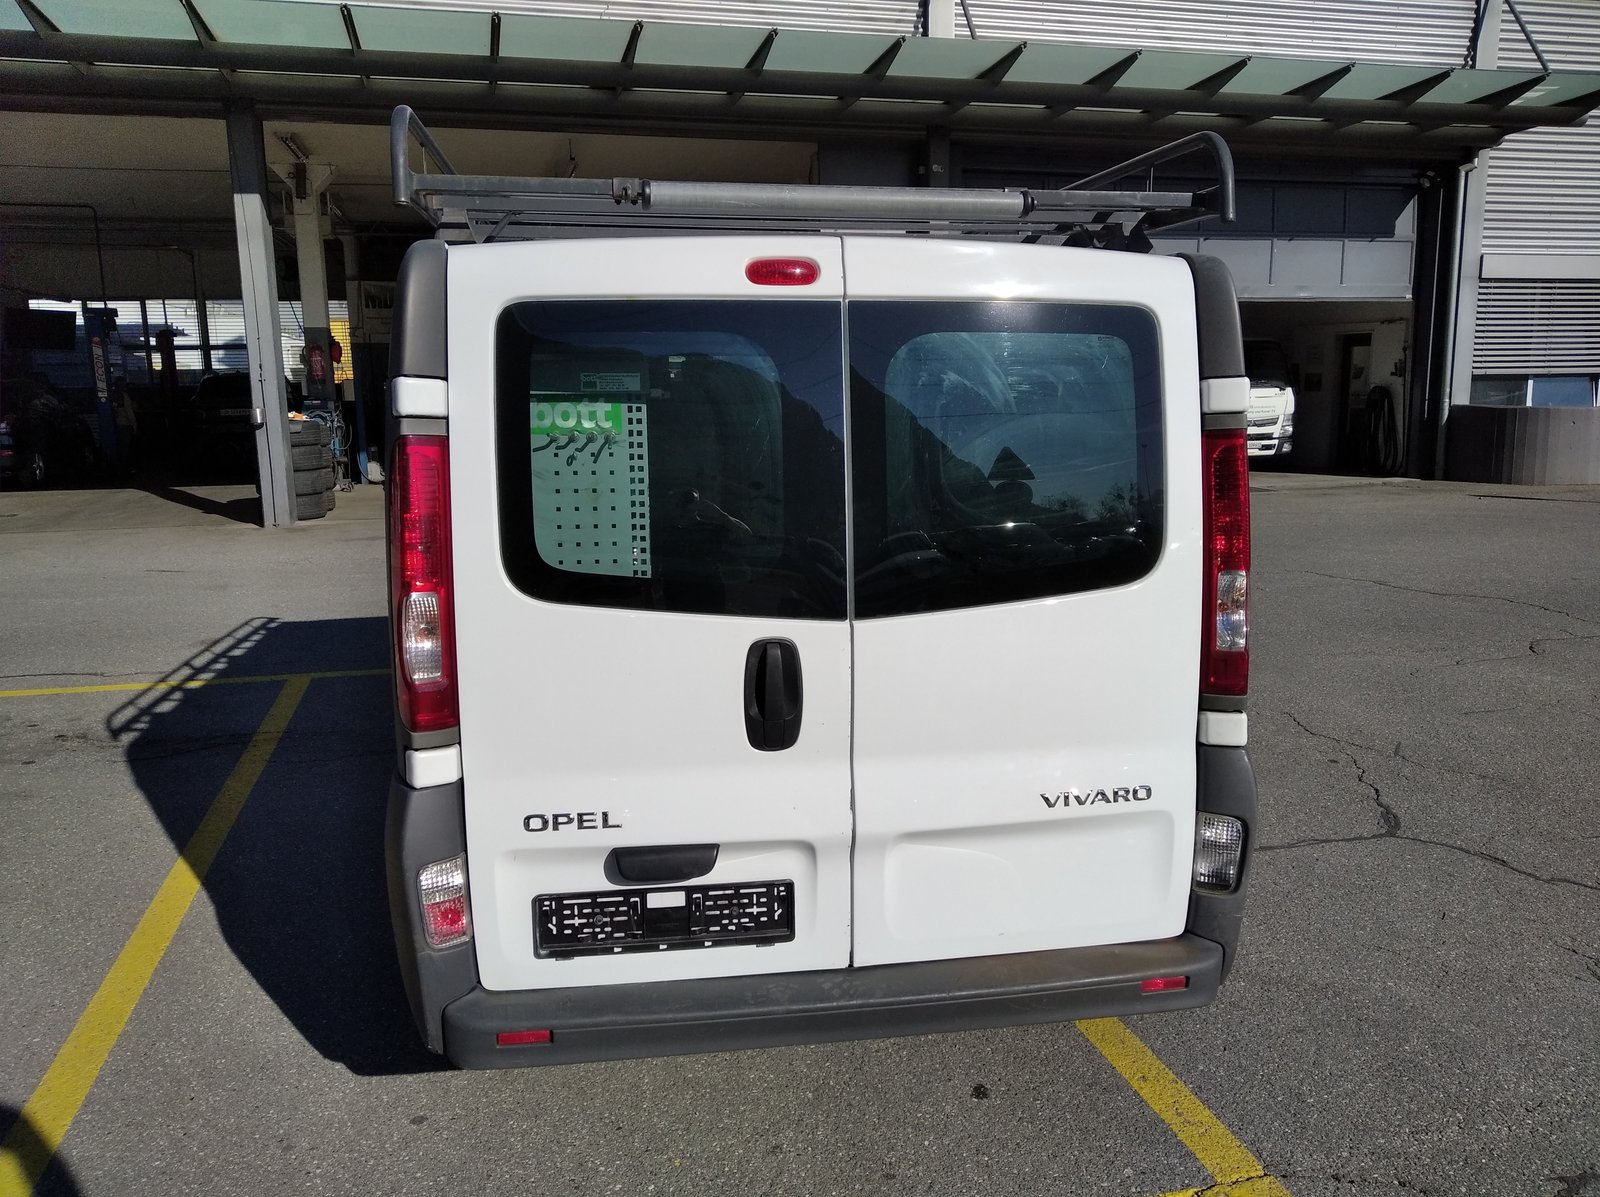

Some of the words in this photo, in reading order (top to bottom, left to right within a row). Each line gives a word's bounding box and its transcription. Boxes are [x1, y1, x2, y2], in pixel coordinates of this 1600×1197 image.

[94, 353, 105, 383] ECON
[530, 397, 613, 429] bott
[1039, 784, 1153, 809] VIVARO
[522, 810, 623, 833] OPEL
